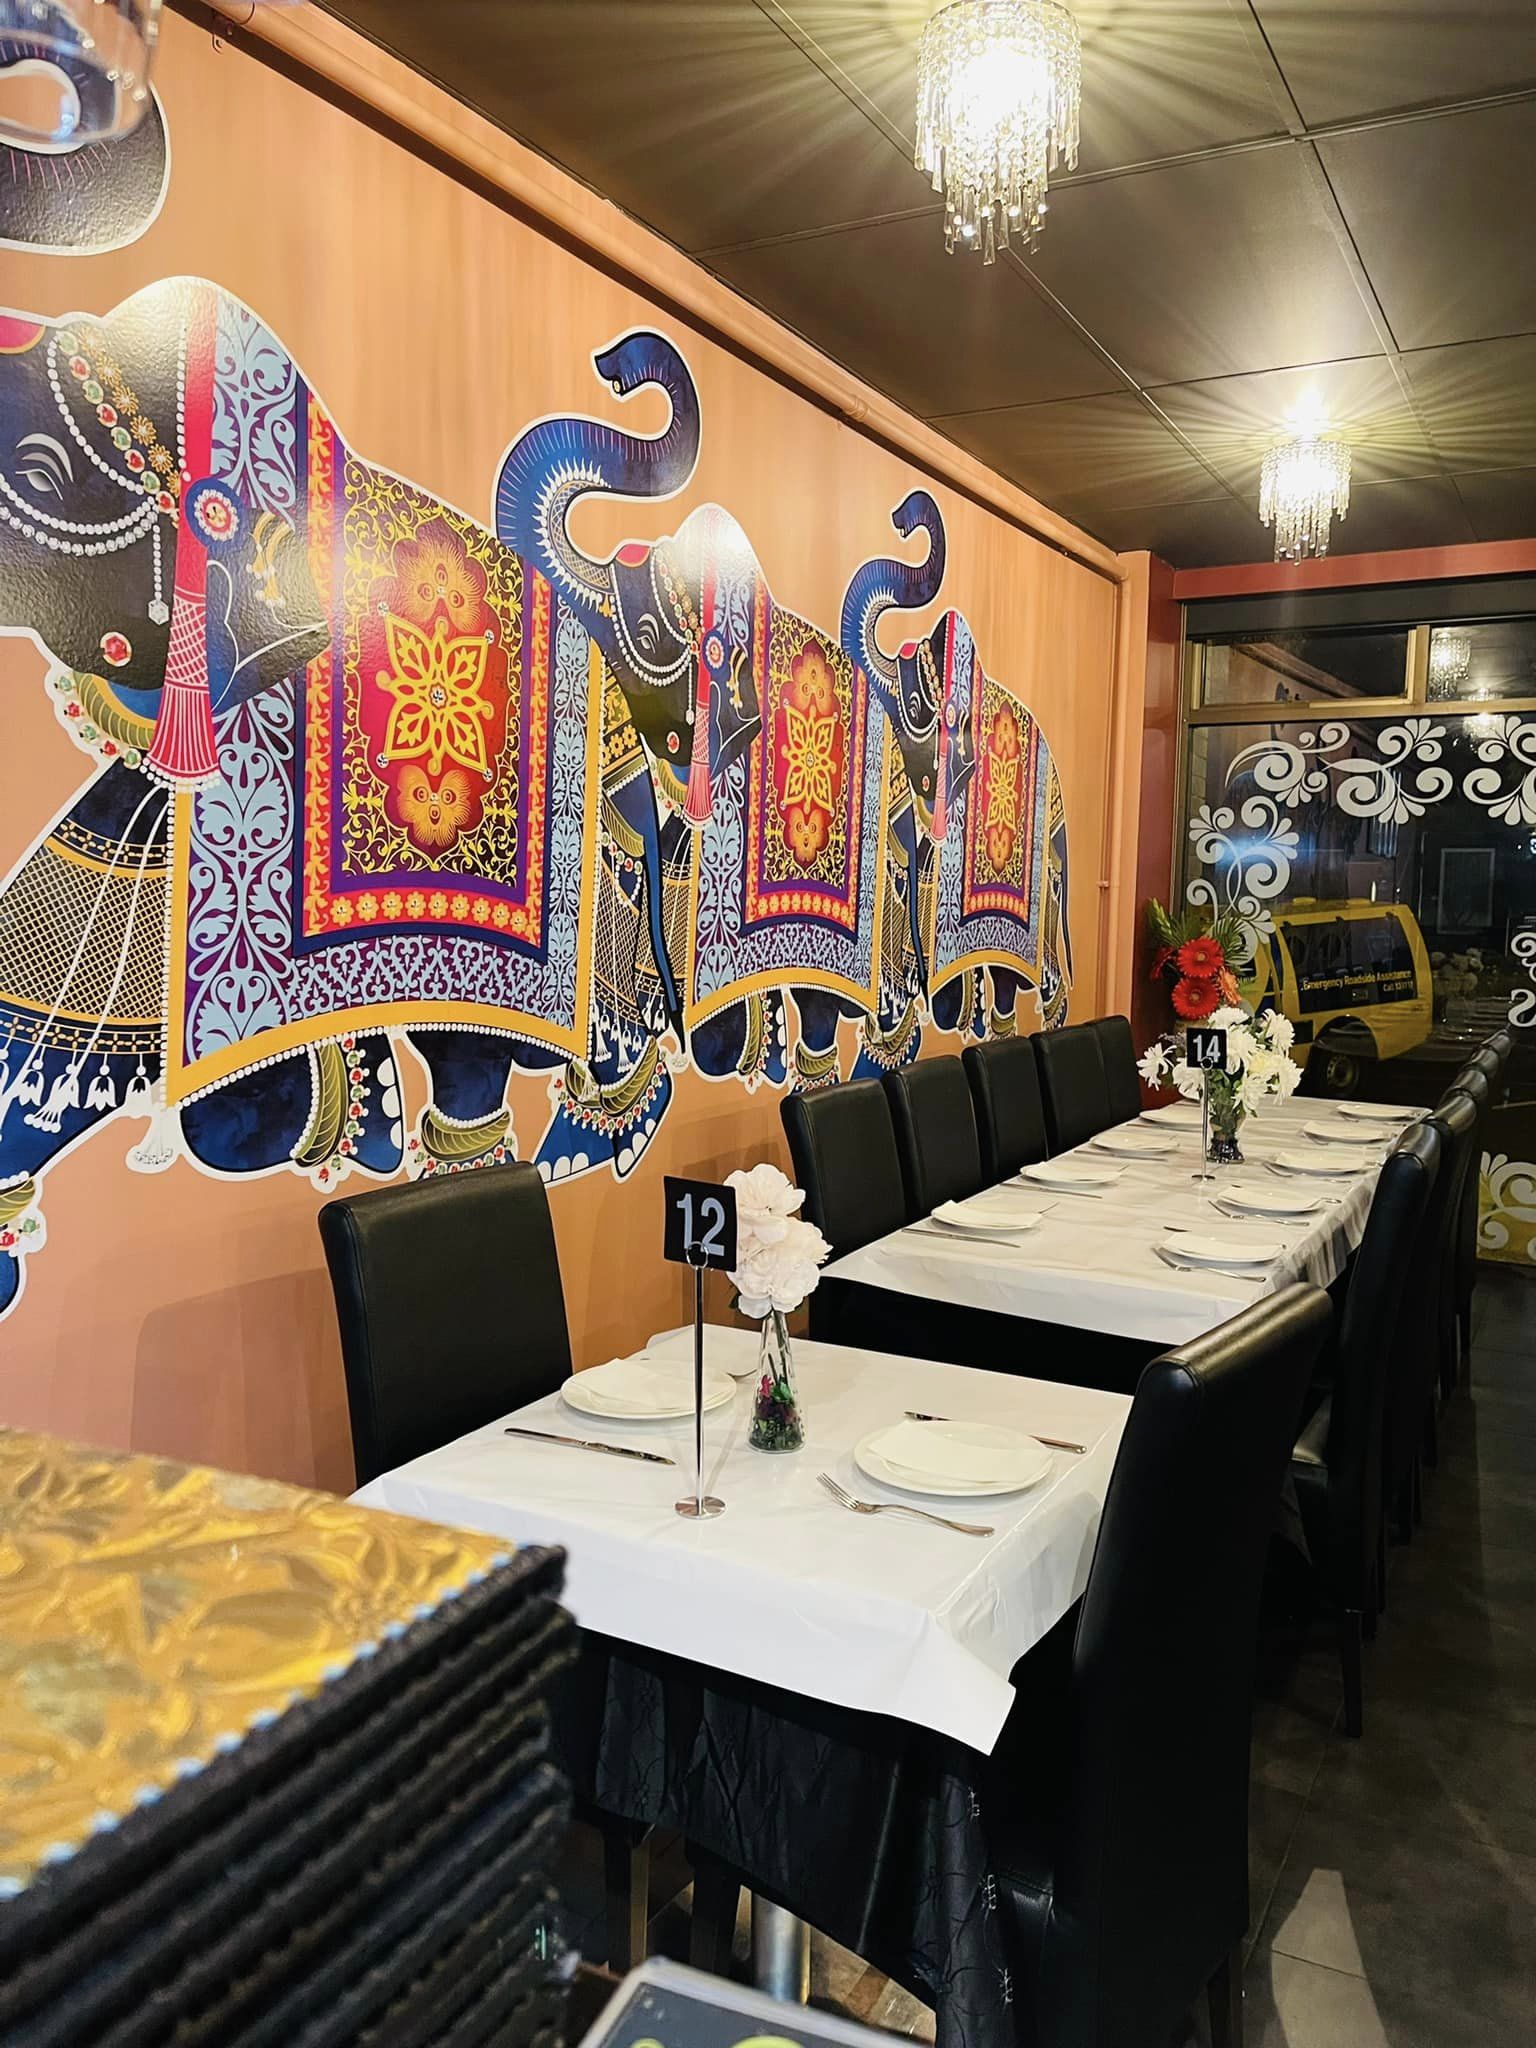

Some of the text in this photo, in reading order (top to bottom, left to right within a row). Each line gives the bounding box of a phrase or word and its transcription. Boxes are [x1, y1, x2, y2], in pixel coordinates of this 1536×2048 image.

[1303, 971, 1411, 990] Emergency Roadside Assistance
[1193, 1034, 1221, 1063] 14
[676, 1193, 725, 1256] 12
